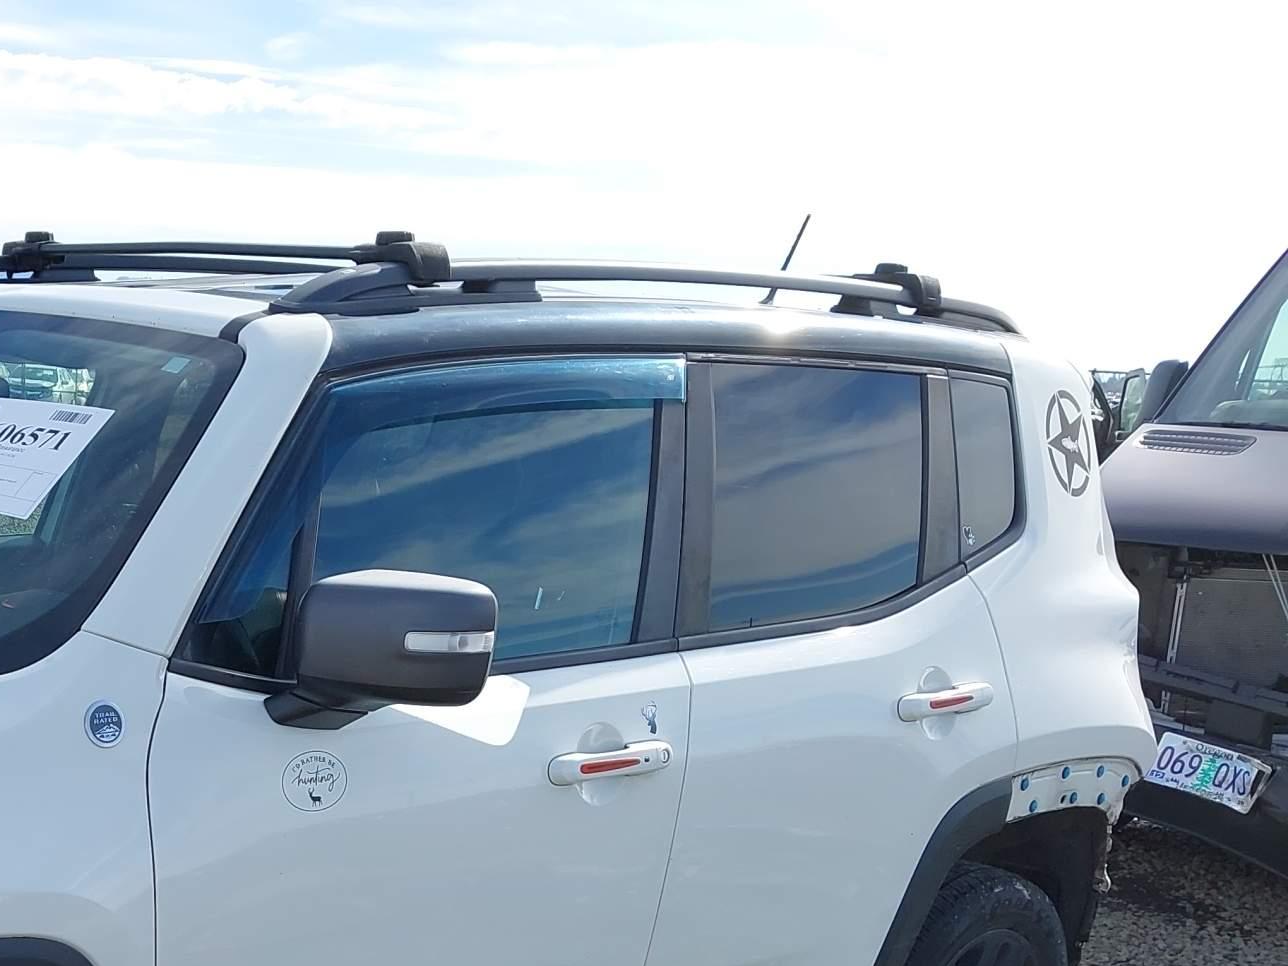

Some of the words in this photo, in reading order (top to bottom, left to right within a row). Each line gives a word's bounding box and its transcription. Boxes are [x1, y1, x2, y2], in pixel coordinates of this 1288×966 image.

[291, 765, 341, 792] hunting
[1156, 746, 1203, 778] 069
[1212, 763, 1250, 796] QXS
